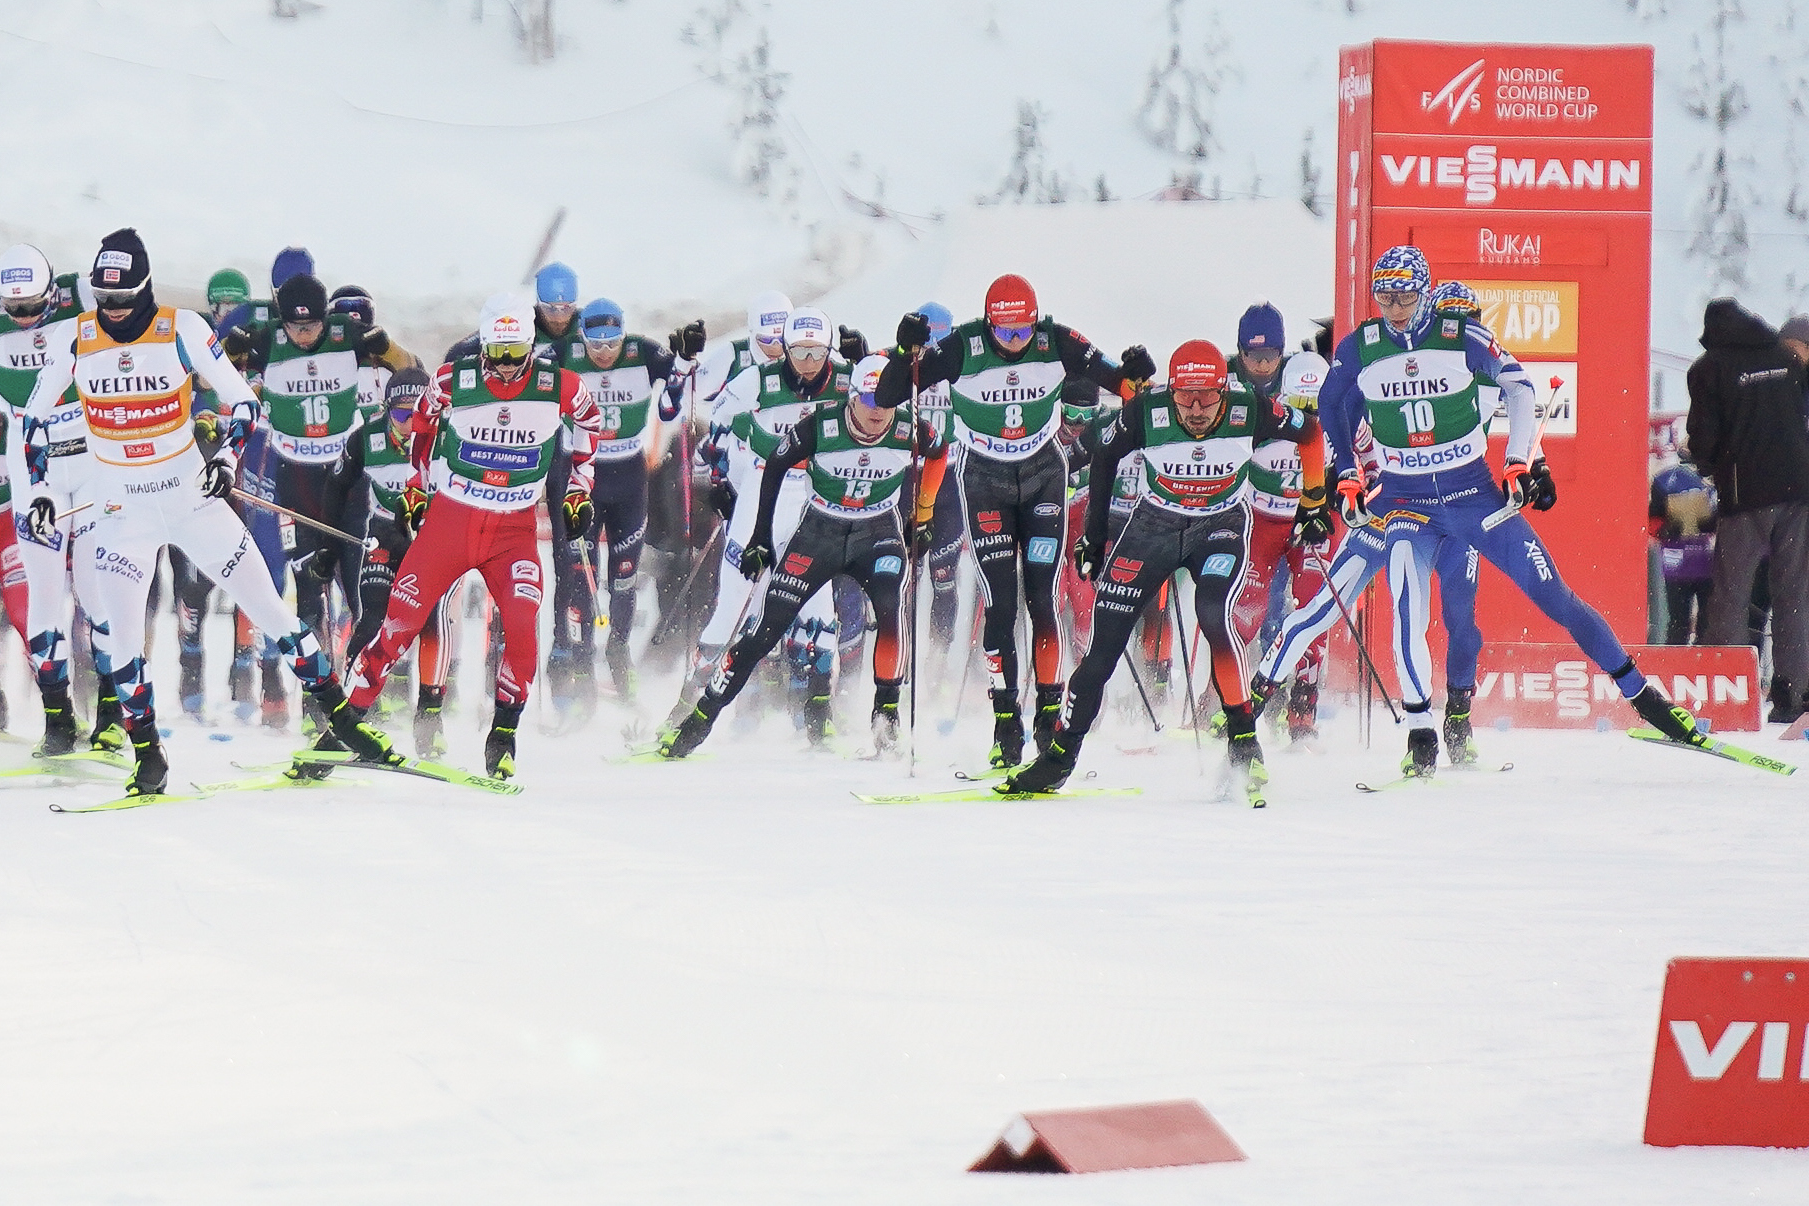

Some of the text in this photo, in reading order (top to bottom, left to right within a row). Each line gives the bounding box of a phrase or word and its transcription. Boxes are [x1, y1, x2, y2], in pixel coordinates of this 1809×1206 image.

[1497, 68, 1564, 83] NORDIC
[1497, 85, 1590, 102] COMBINED
[1497, 102, 1599, 119] WORLD CUP
[1381, 145, 1641, 204] VIESSMANN
[1479, 227, 1541, 256] RUKA!
[1506, 290, 1523, 303] THE
[1524, 290, 1560, 304] OFFICIAL
[1504, 305, 1561, 340] APP
[9, 352, 48, 366] VELT
[89, 376, 170, 394] VELTINS
[286, 378, 341, 393] VELTINS
[1380, 378, 1449, 398] VELTINS
[981, 386, 1046, 403] VELTINS
[87, 400, 180, 425] VIESSMANN
[300, 395, 331, 426] 16
[1004, 404, 1024, 429] 8
[1399, 399, 1436, 434] 10
[470, 426, 536, 444] VELTINS
[470, 450, 528, 464] BEST JUMPER
[1383, 443, 1472, 469] Webasto
[833, 466, 893, 478] VELTINS
[1163, 461, 1234, 476] VELTINS
[124, 476, 181, 496] THAUGLAND
[448, 472, 534, 503] Webasto
[844, 479, 873, 498] 13
[1172, 481, 1195, 492] BEST
[107, 552, 144, 579] OBOS
[221, 535, 251, 579] CRAFT
[1105, 600, 1135, 613] TERREX
[1750, 754, 1786, 772] FISCHER
[464, 776, 510, 793] FISCHER
